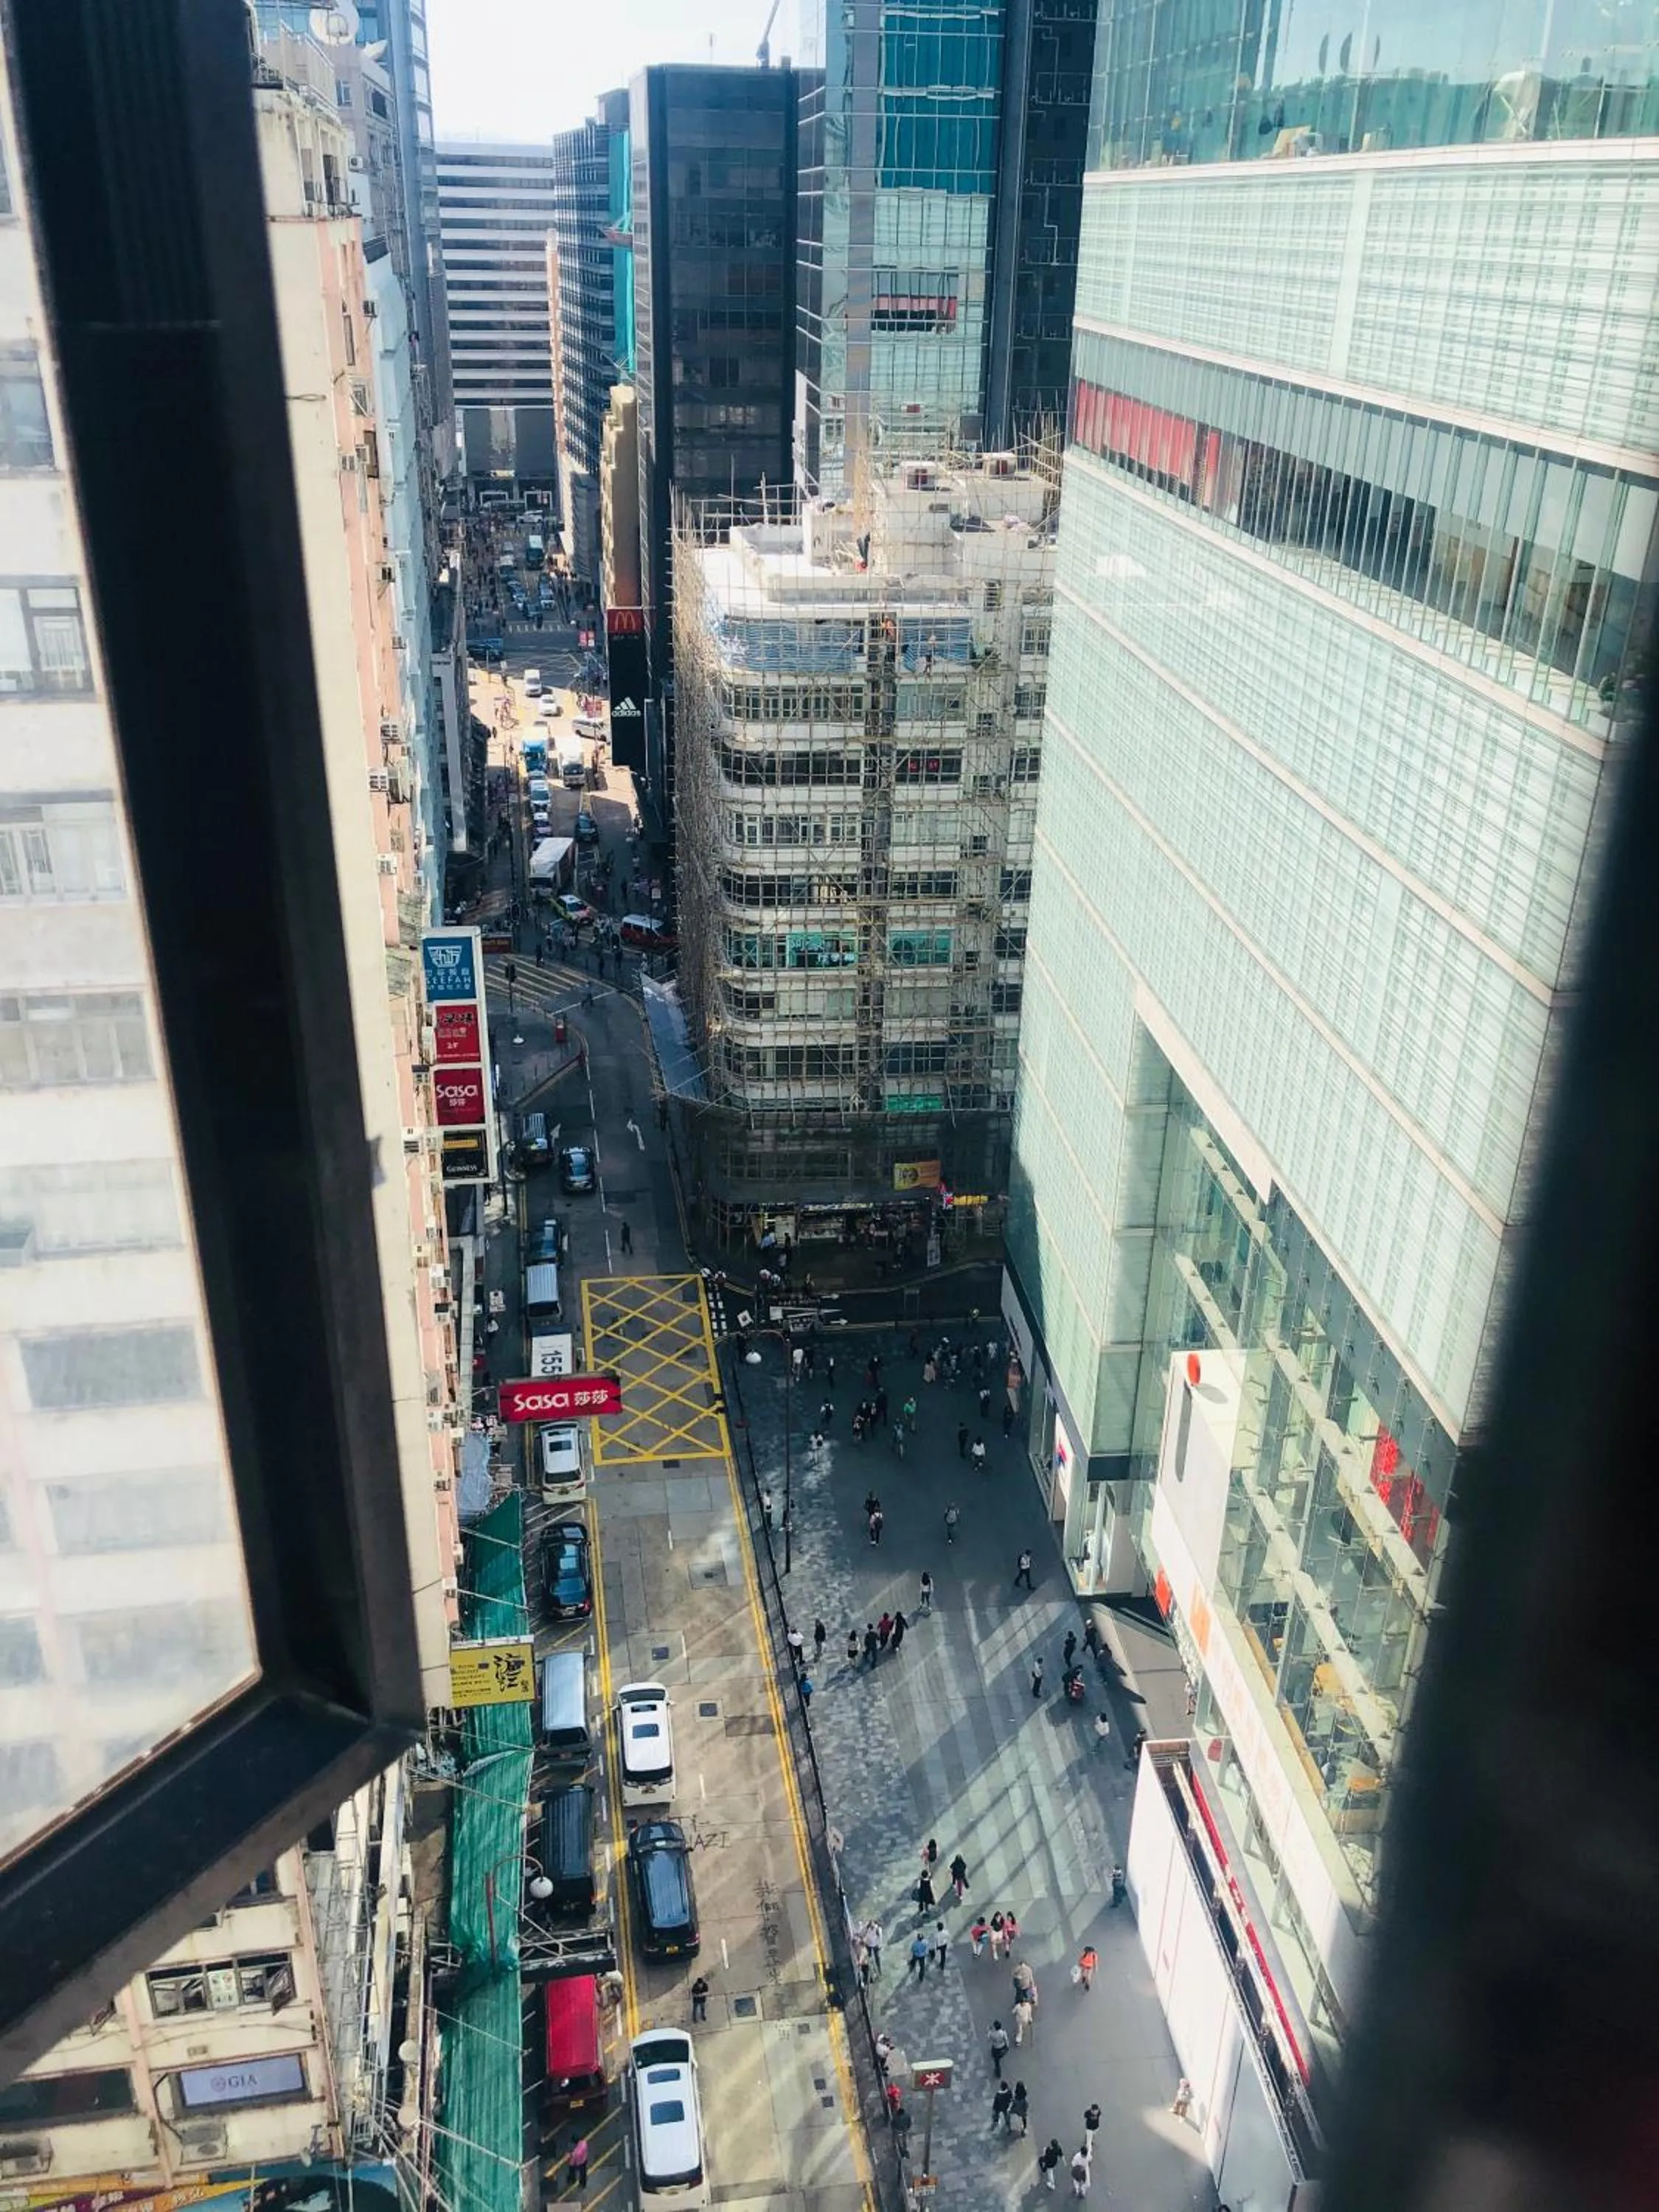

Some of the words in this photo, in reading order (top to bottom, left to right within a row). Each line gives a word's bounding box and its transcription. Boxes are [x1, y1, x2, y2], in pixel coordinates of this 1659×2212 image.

[611, 709, 641, 717] adidas
[574, 1389, 608, 1406] 莎莎
[228, 2074, 258, 2088] GIA
